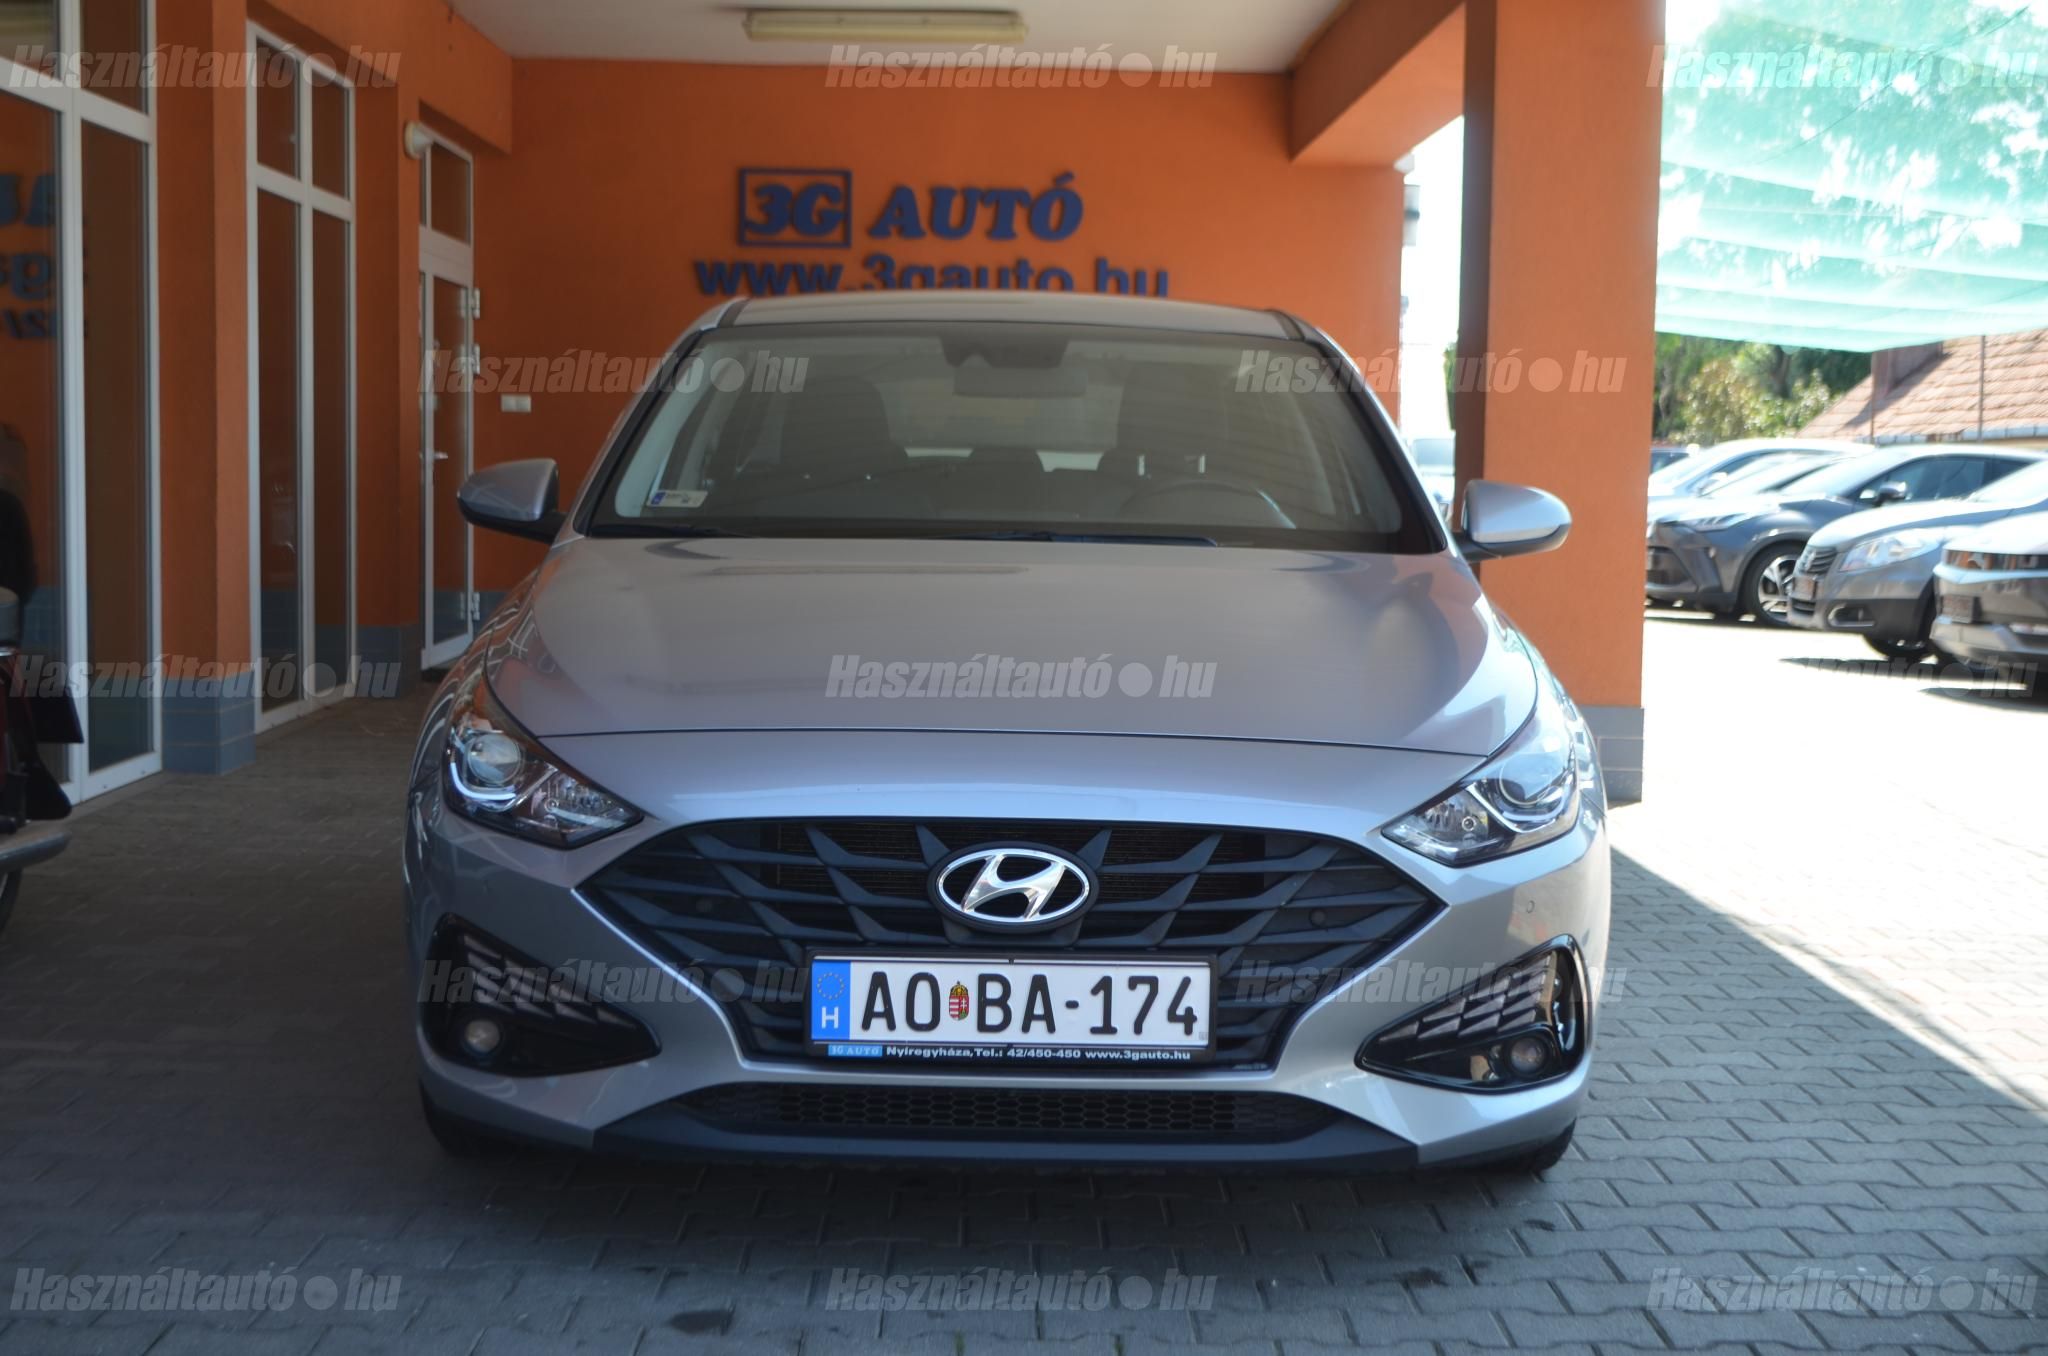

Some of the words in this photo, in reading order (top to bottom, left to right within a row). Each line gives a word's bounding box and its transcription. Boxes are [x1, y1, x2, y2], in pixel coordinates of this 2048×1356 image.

[744, 183, 845, 236] 3G
[867, 172, 1083, 241] AUTÓ
[821, 1006, 839, 1029] H
[1007, 1048, 1081, 1059] 42/450-450
[1085, 1049, 1191, 1061] www.3gauto.hu
